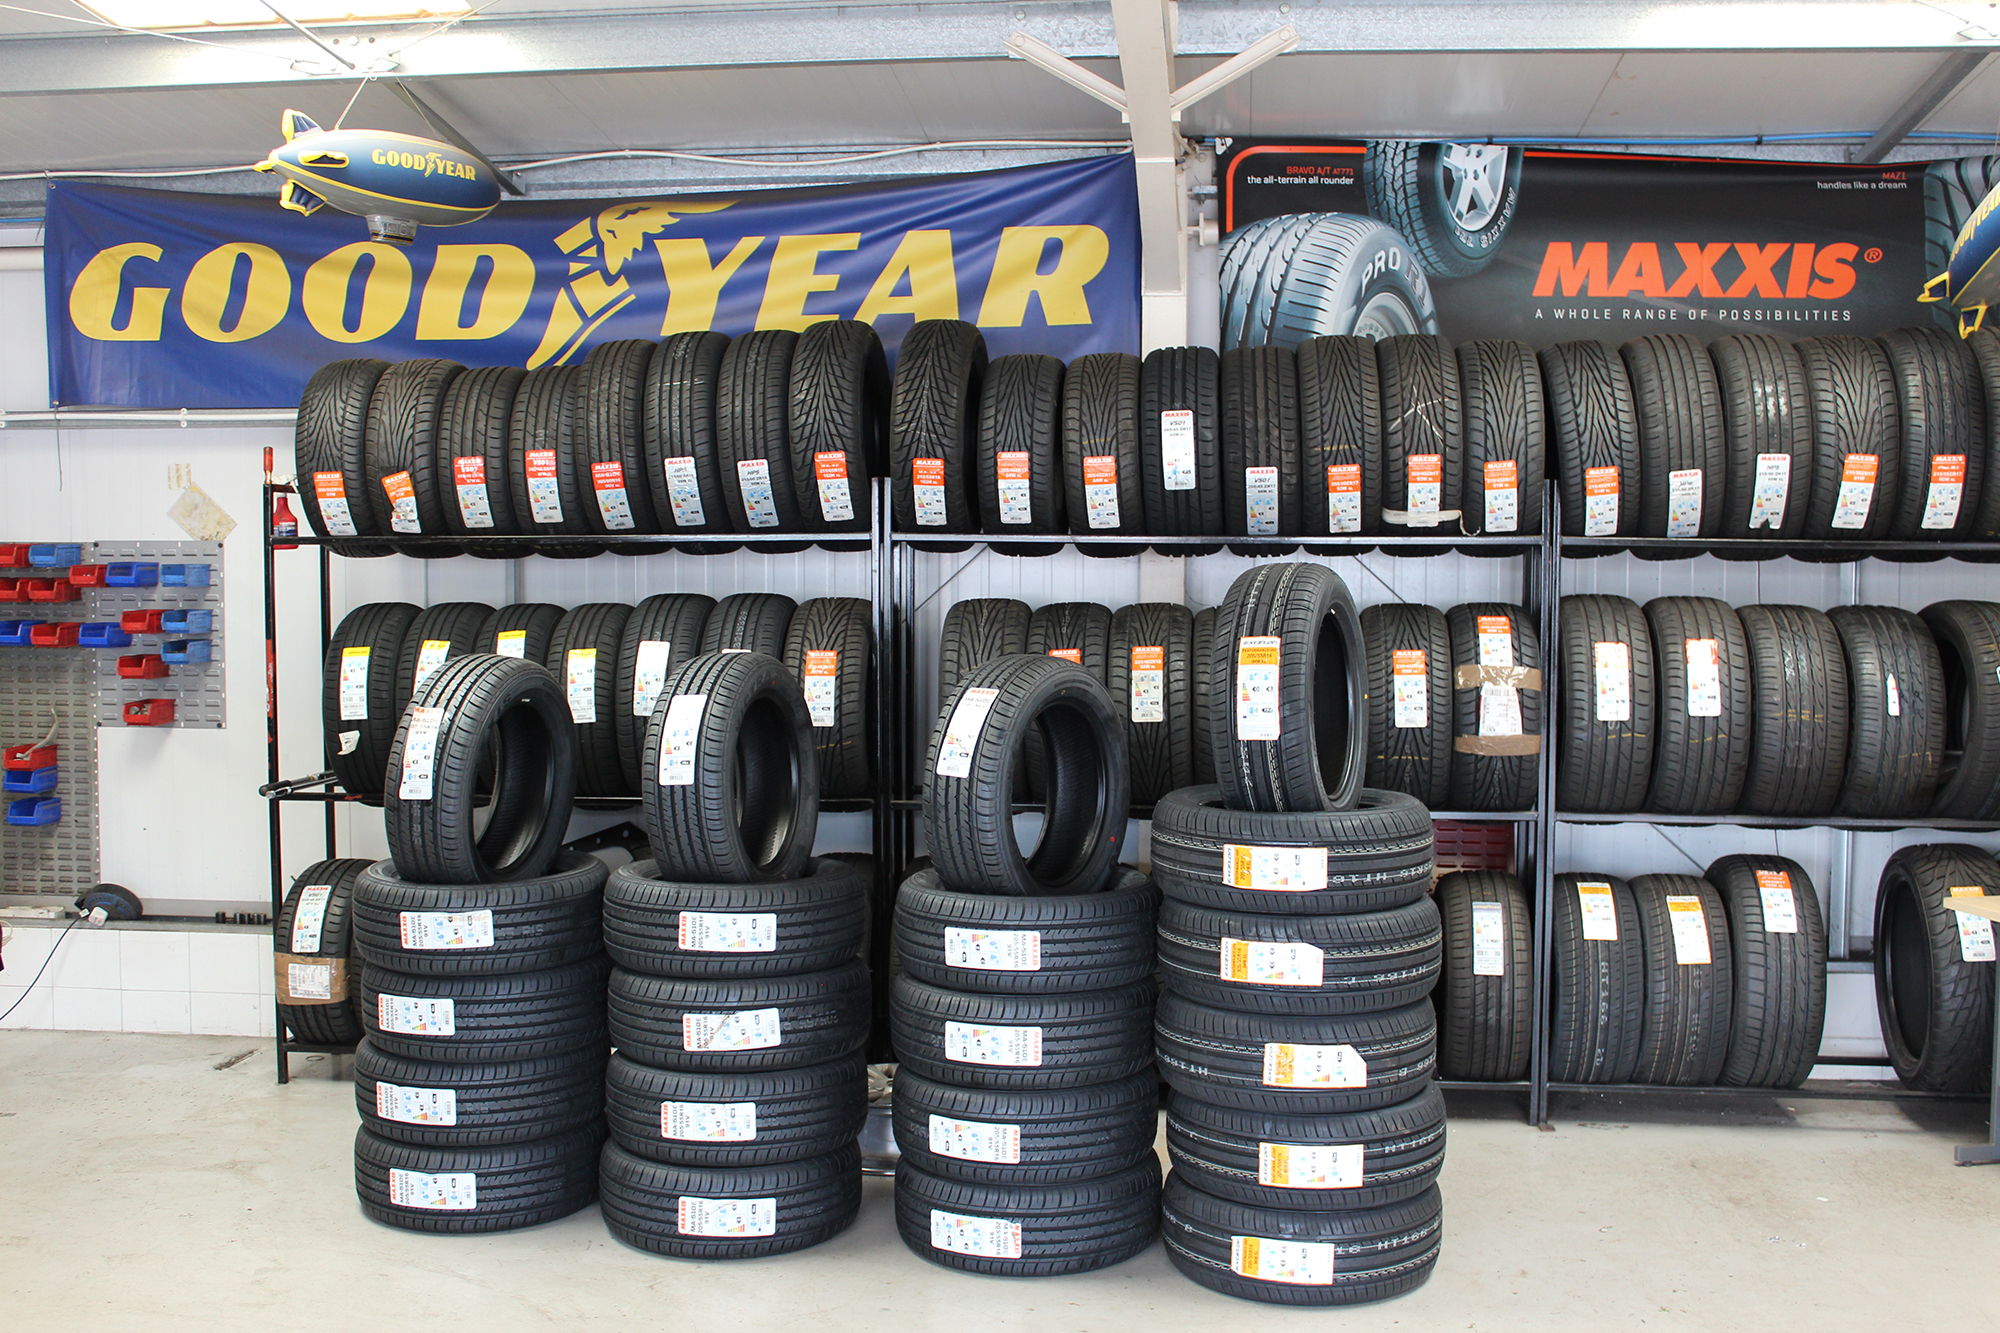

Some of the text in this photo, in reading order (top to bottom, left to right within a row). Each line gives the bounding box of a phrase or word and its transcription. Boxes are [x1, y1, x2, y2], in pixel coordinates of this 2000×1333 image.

[371, 149, 476, 181] GOOD YEAR
[1286, 166, 1316, 174] BRAVO
[1316, 166, 1331, 175] A/T
[1247, 176, 1354, 184] the all-terrain all rounder
[1882, 172, 1906, 180] MAZ1
[1816, 181, 1852, 189] handles
[1853, 181, 1869, 189] like
[1878, 181, 1907, 189] dream
[1362, 246, 1400, 298] PRO
[1532, 241, 1860, 300] MAXXIS
[70, 224, 1110, 343] GOOD YEAR
[1534, 308, 1851, 322] A WHOLE RANGE OF POSSIBILITIES
[385, 474, 408, 484] MAXXIS
[1378, 1228, 1428, 1250] HT166
